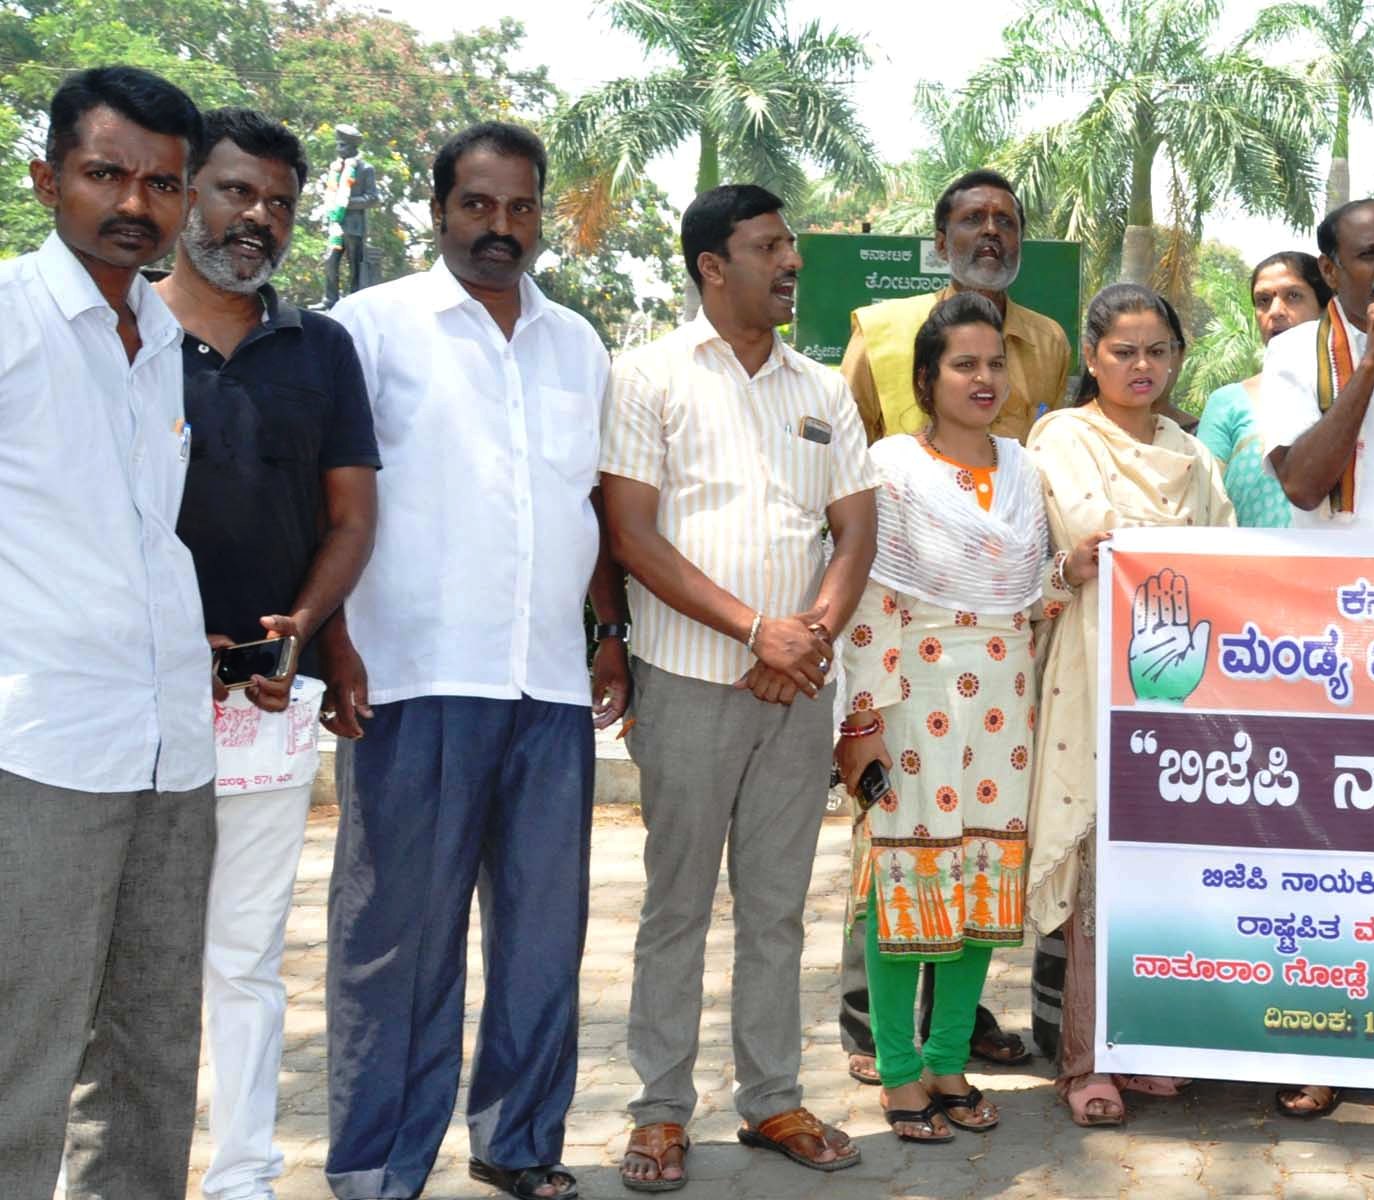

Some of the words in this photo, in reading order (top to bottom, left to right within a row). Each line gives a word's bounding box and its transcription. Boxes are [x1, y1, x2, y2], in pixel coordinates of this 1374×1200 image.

[860, 248, 912, 261] ಕರ್ನಾಟಕ
[1221, 627, 1350, 700] ಮಂಡ್ಯ
[1202, 863, 1268, 890] ಬಿಜೆಪಿ
[1237, 912, 1341, 954] ರಾಷ್ಟ್ರಪಿತ
[1134, 953, 1273, 983] ನಾತೂರಾಂ
[1283, 958, 1368, 998] ಗೋಡ್ಸೆ
[1263, 1006, 1353, 1033] ದಿನಾಂಕ:
